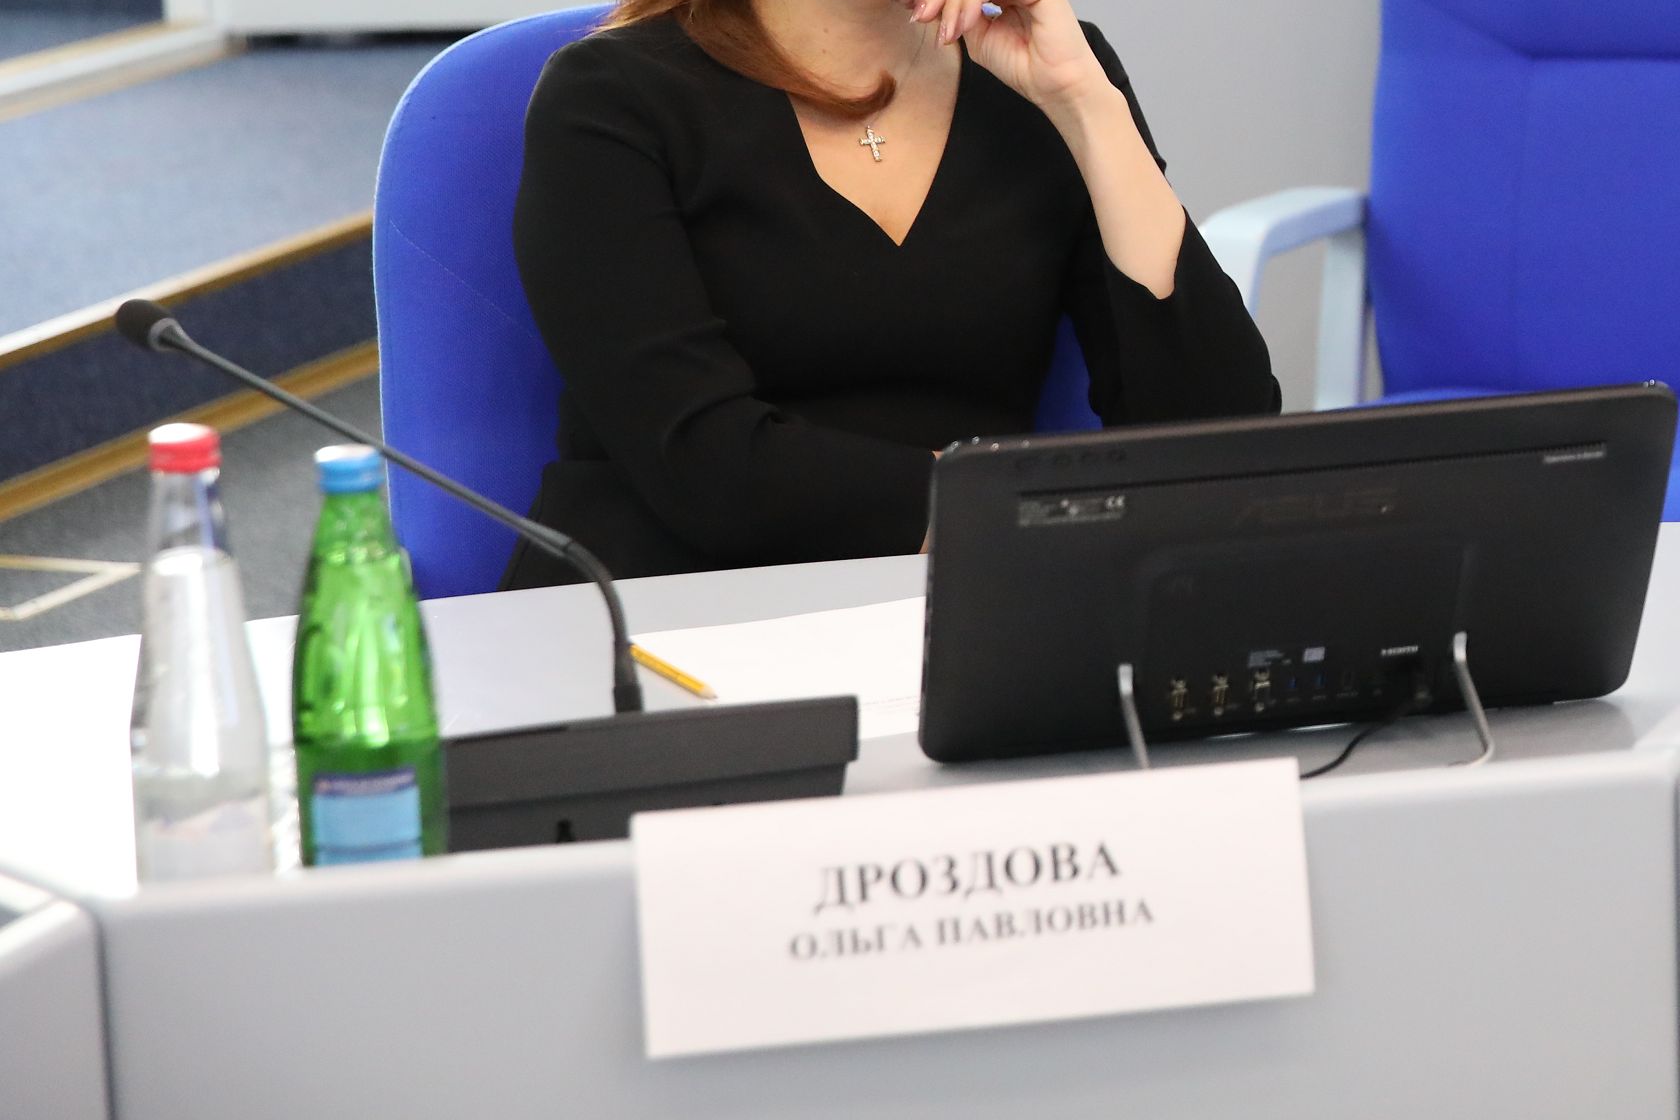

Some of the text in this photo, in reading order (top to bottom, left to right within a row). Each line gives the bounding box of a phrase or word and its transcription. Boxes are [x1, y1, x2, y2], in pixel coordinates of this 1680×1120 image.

[814, 840, 1121, 914] ДРОЗДОВА
[787, 896, 1155, 962] ОЛЬГА ПАВЛОВНА
